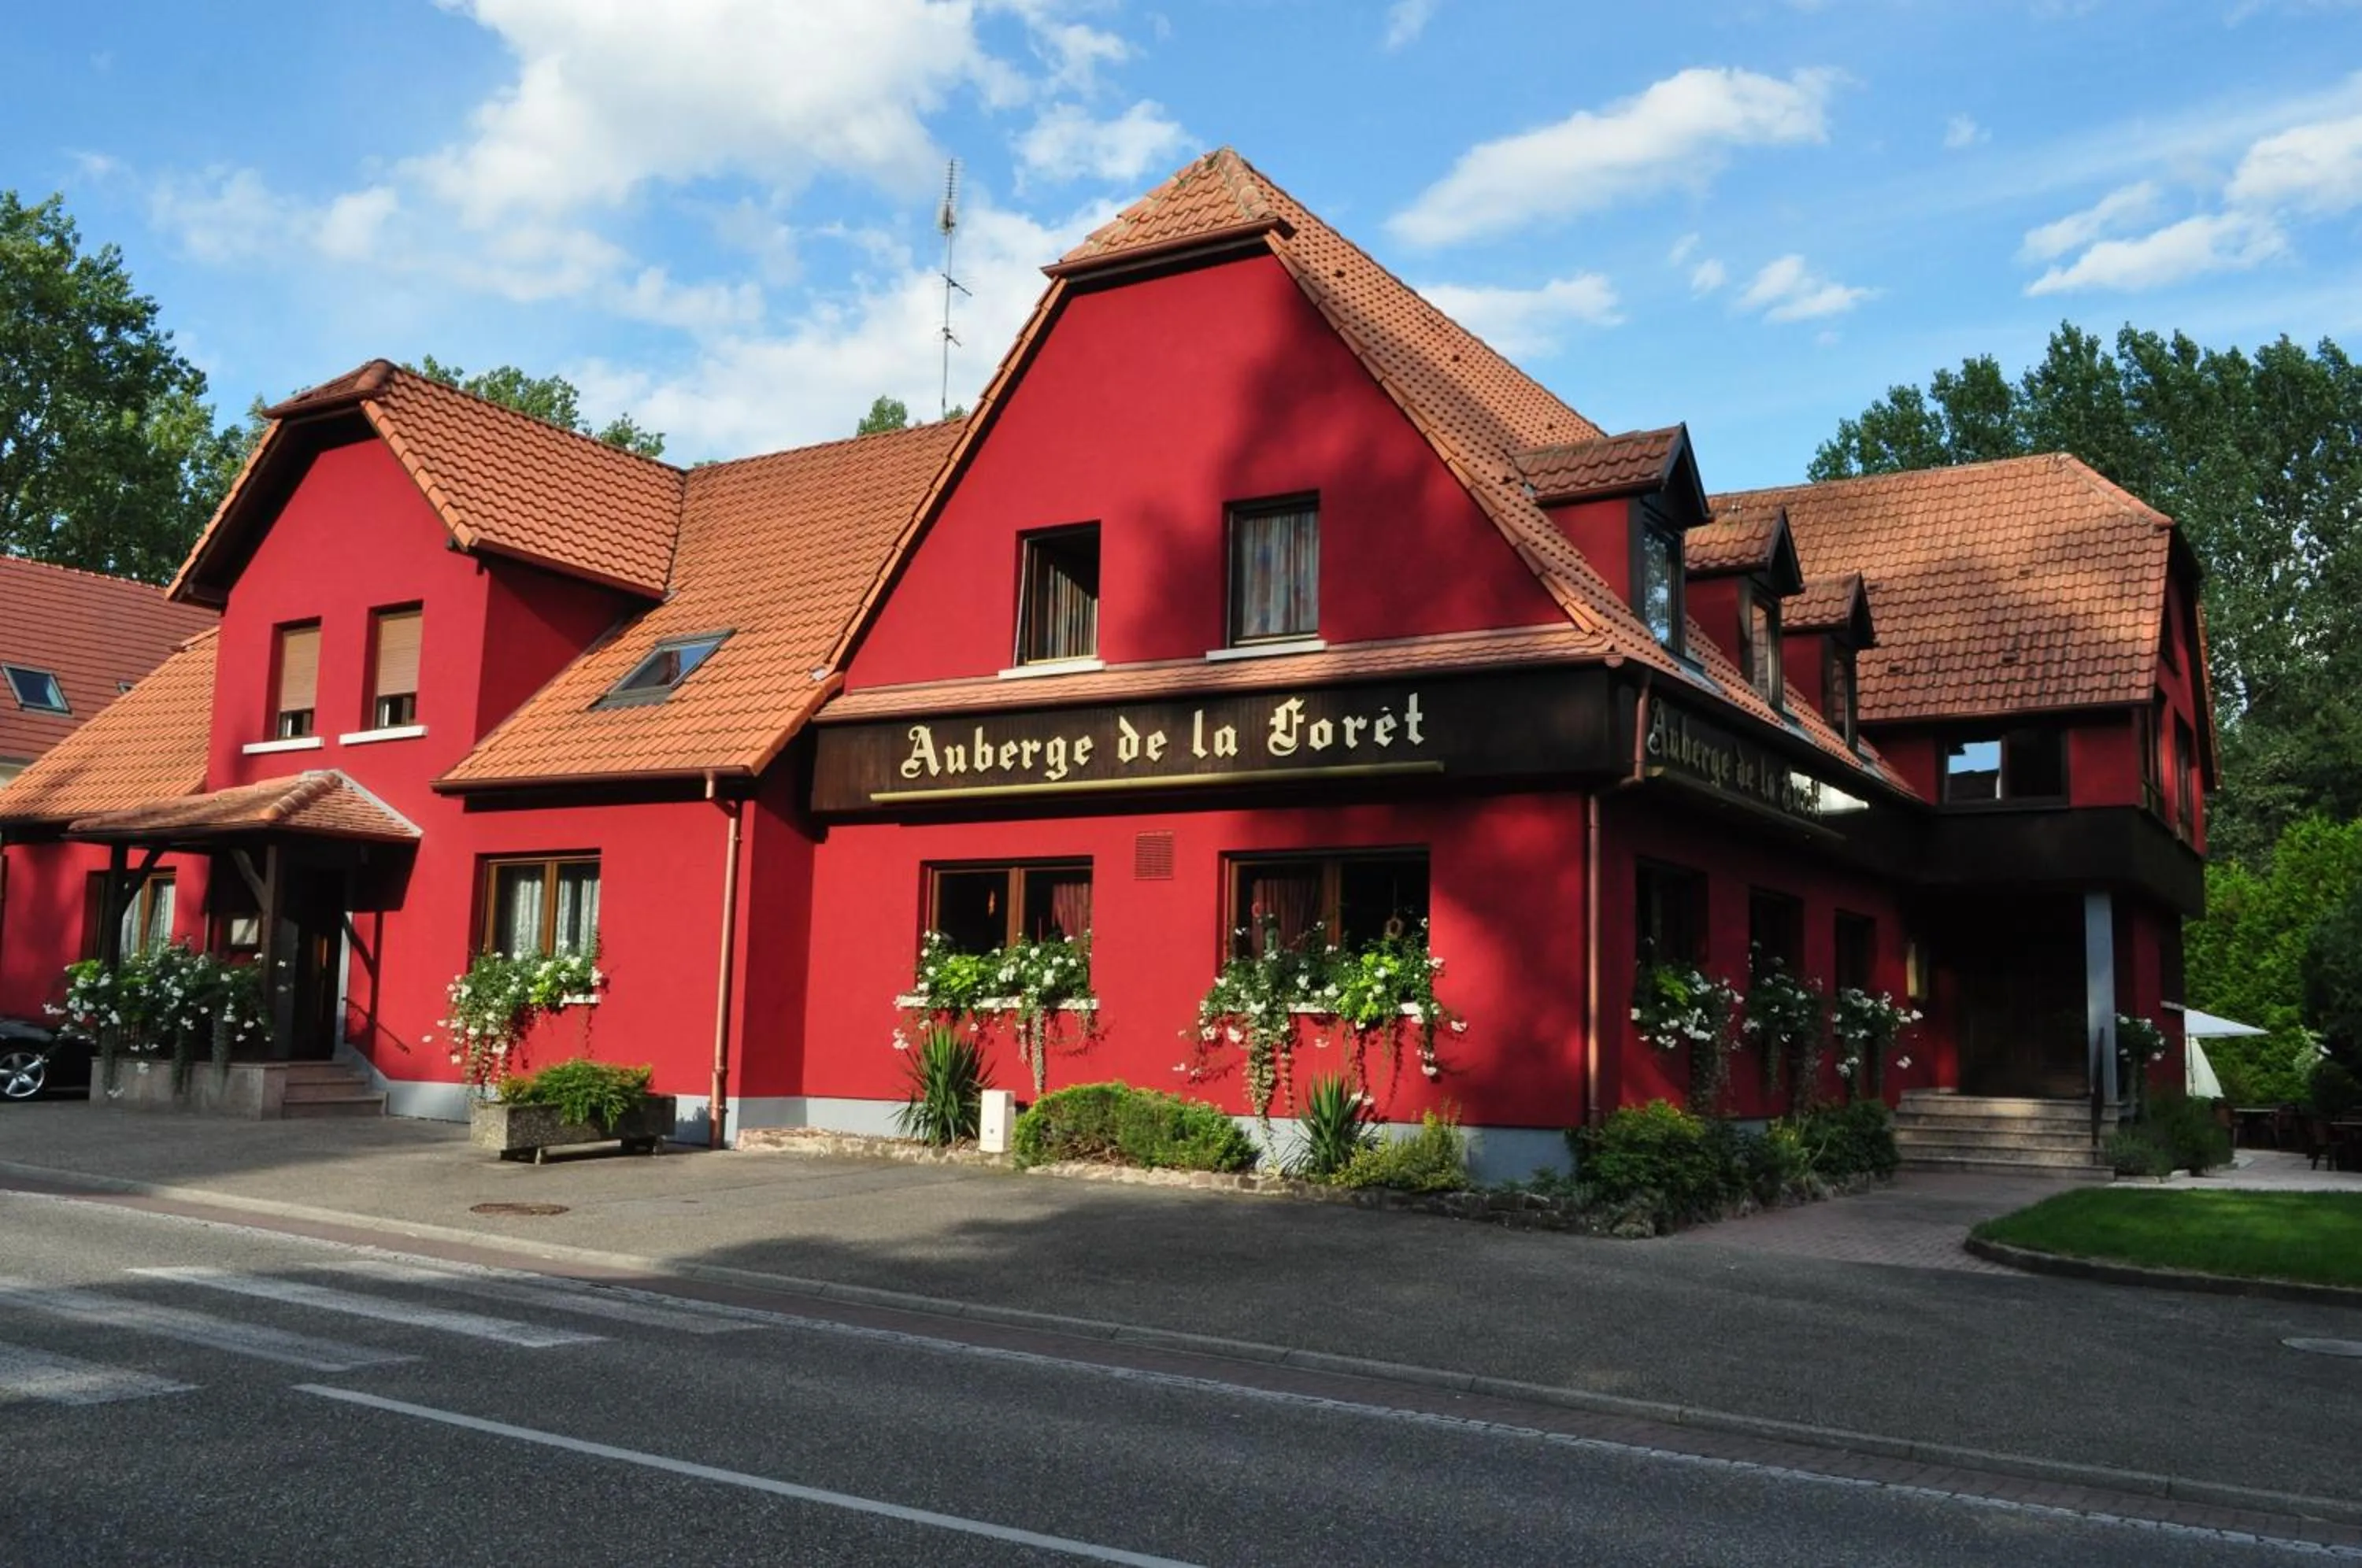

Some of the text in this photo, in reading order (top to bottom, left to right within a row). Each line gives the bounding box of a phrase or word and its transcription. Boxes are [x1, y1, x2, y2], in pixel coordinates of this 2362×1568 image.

[900, 692, 1424, 782] Auberge de la Forêt
[1647, 697, 1731, 789] Auberge
